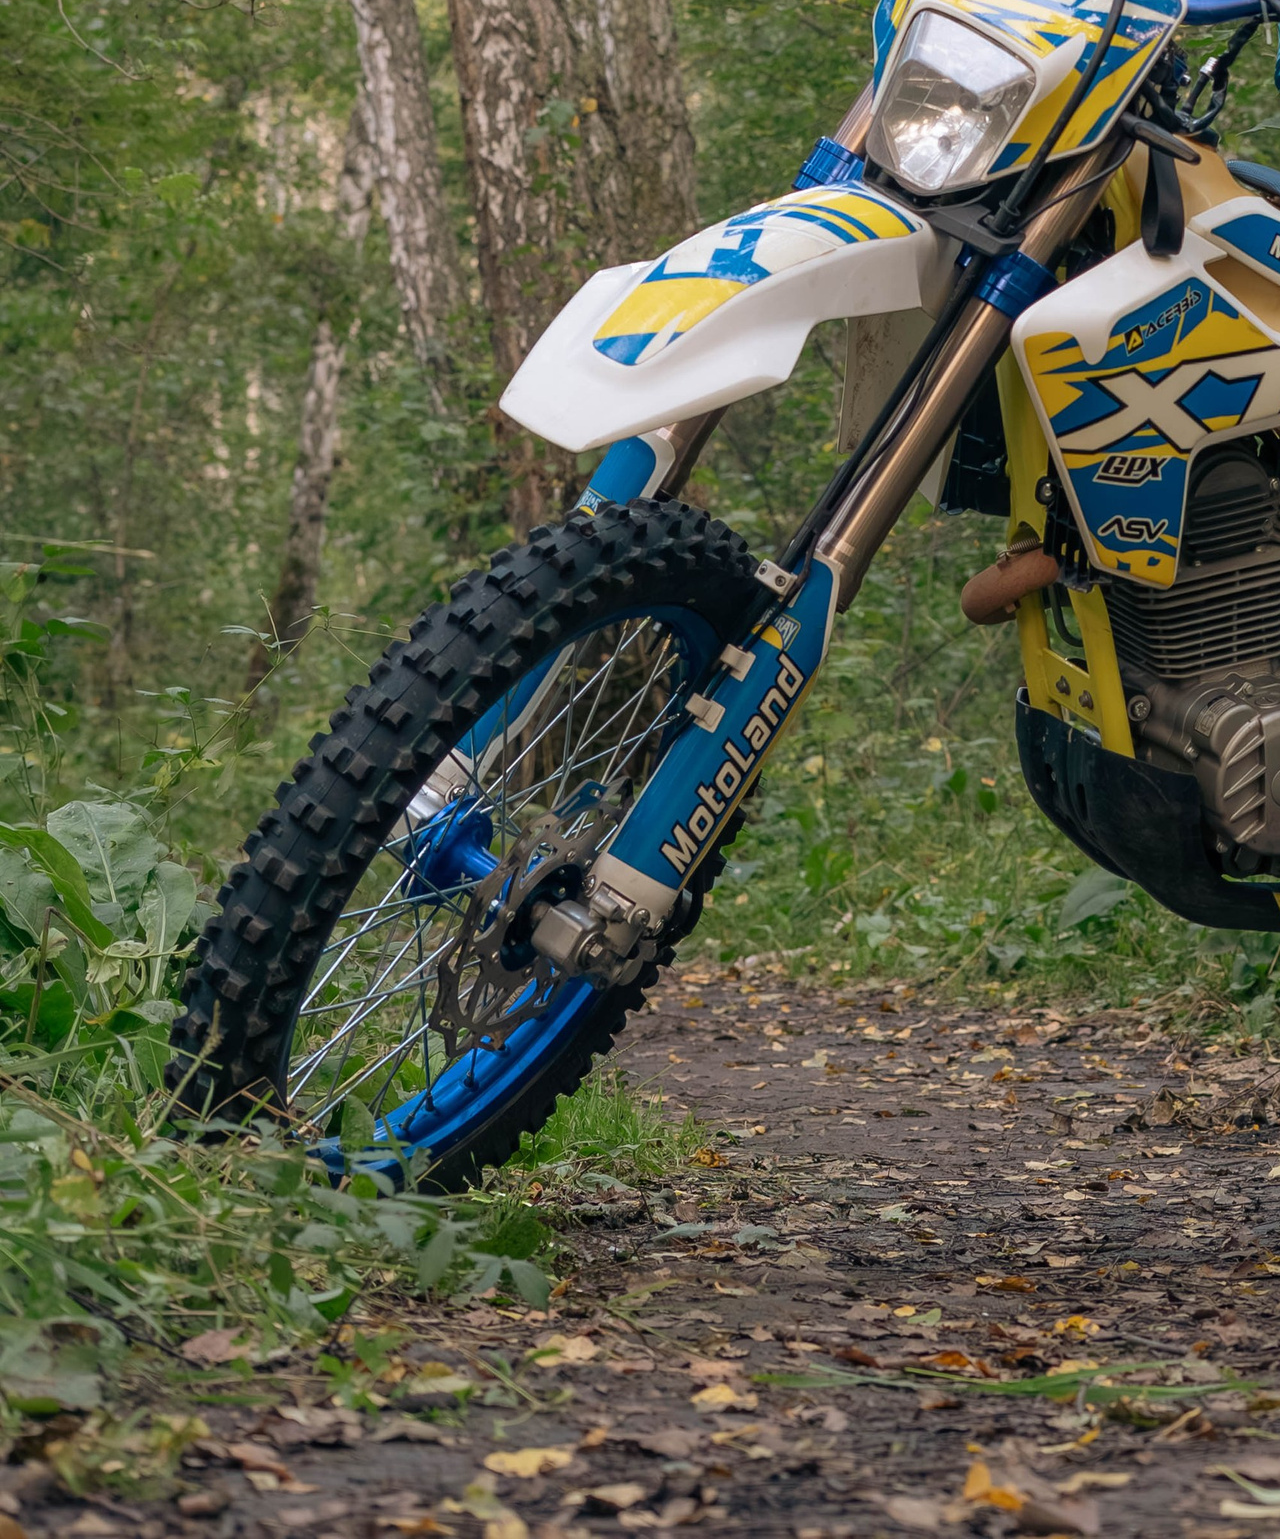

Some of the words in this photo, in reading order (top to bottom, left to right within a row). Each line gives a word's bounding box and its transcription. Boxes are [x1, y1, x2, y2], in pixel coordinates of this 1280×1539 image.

[1098, 454, 1171, 485] GPX
[1098, 515, 1168, 542] ASV
[659, 651, 805, 876] MotoLand
